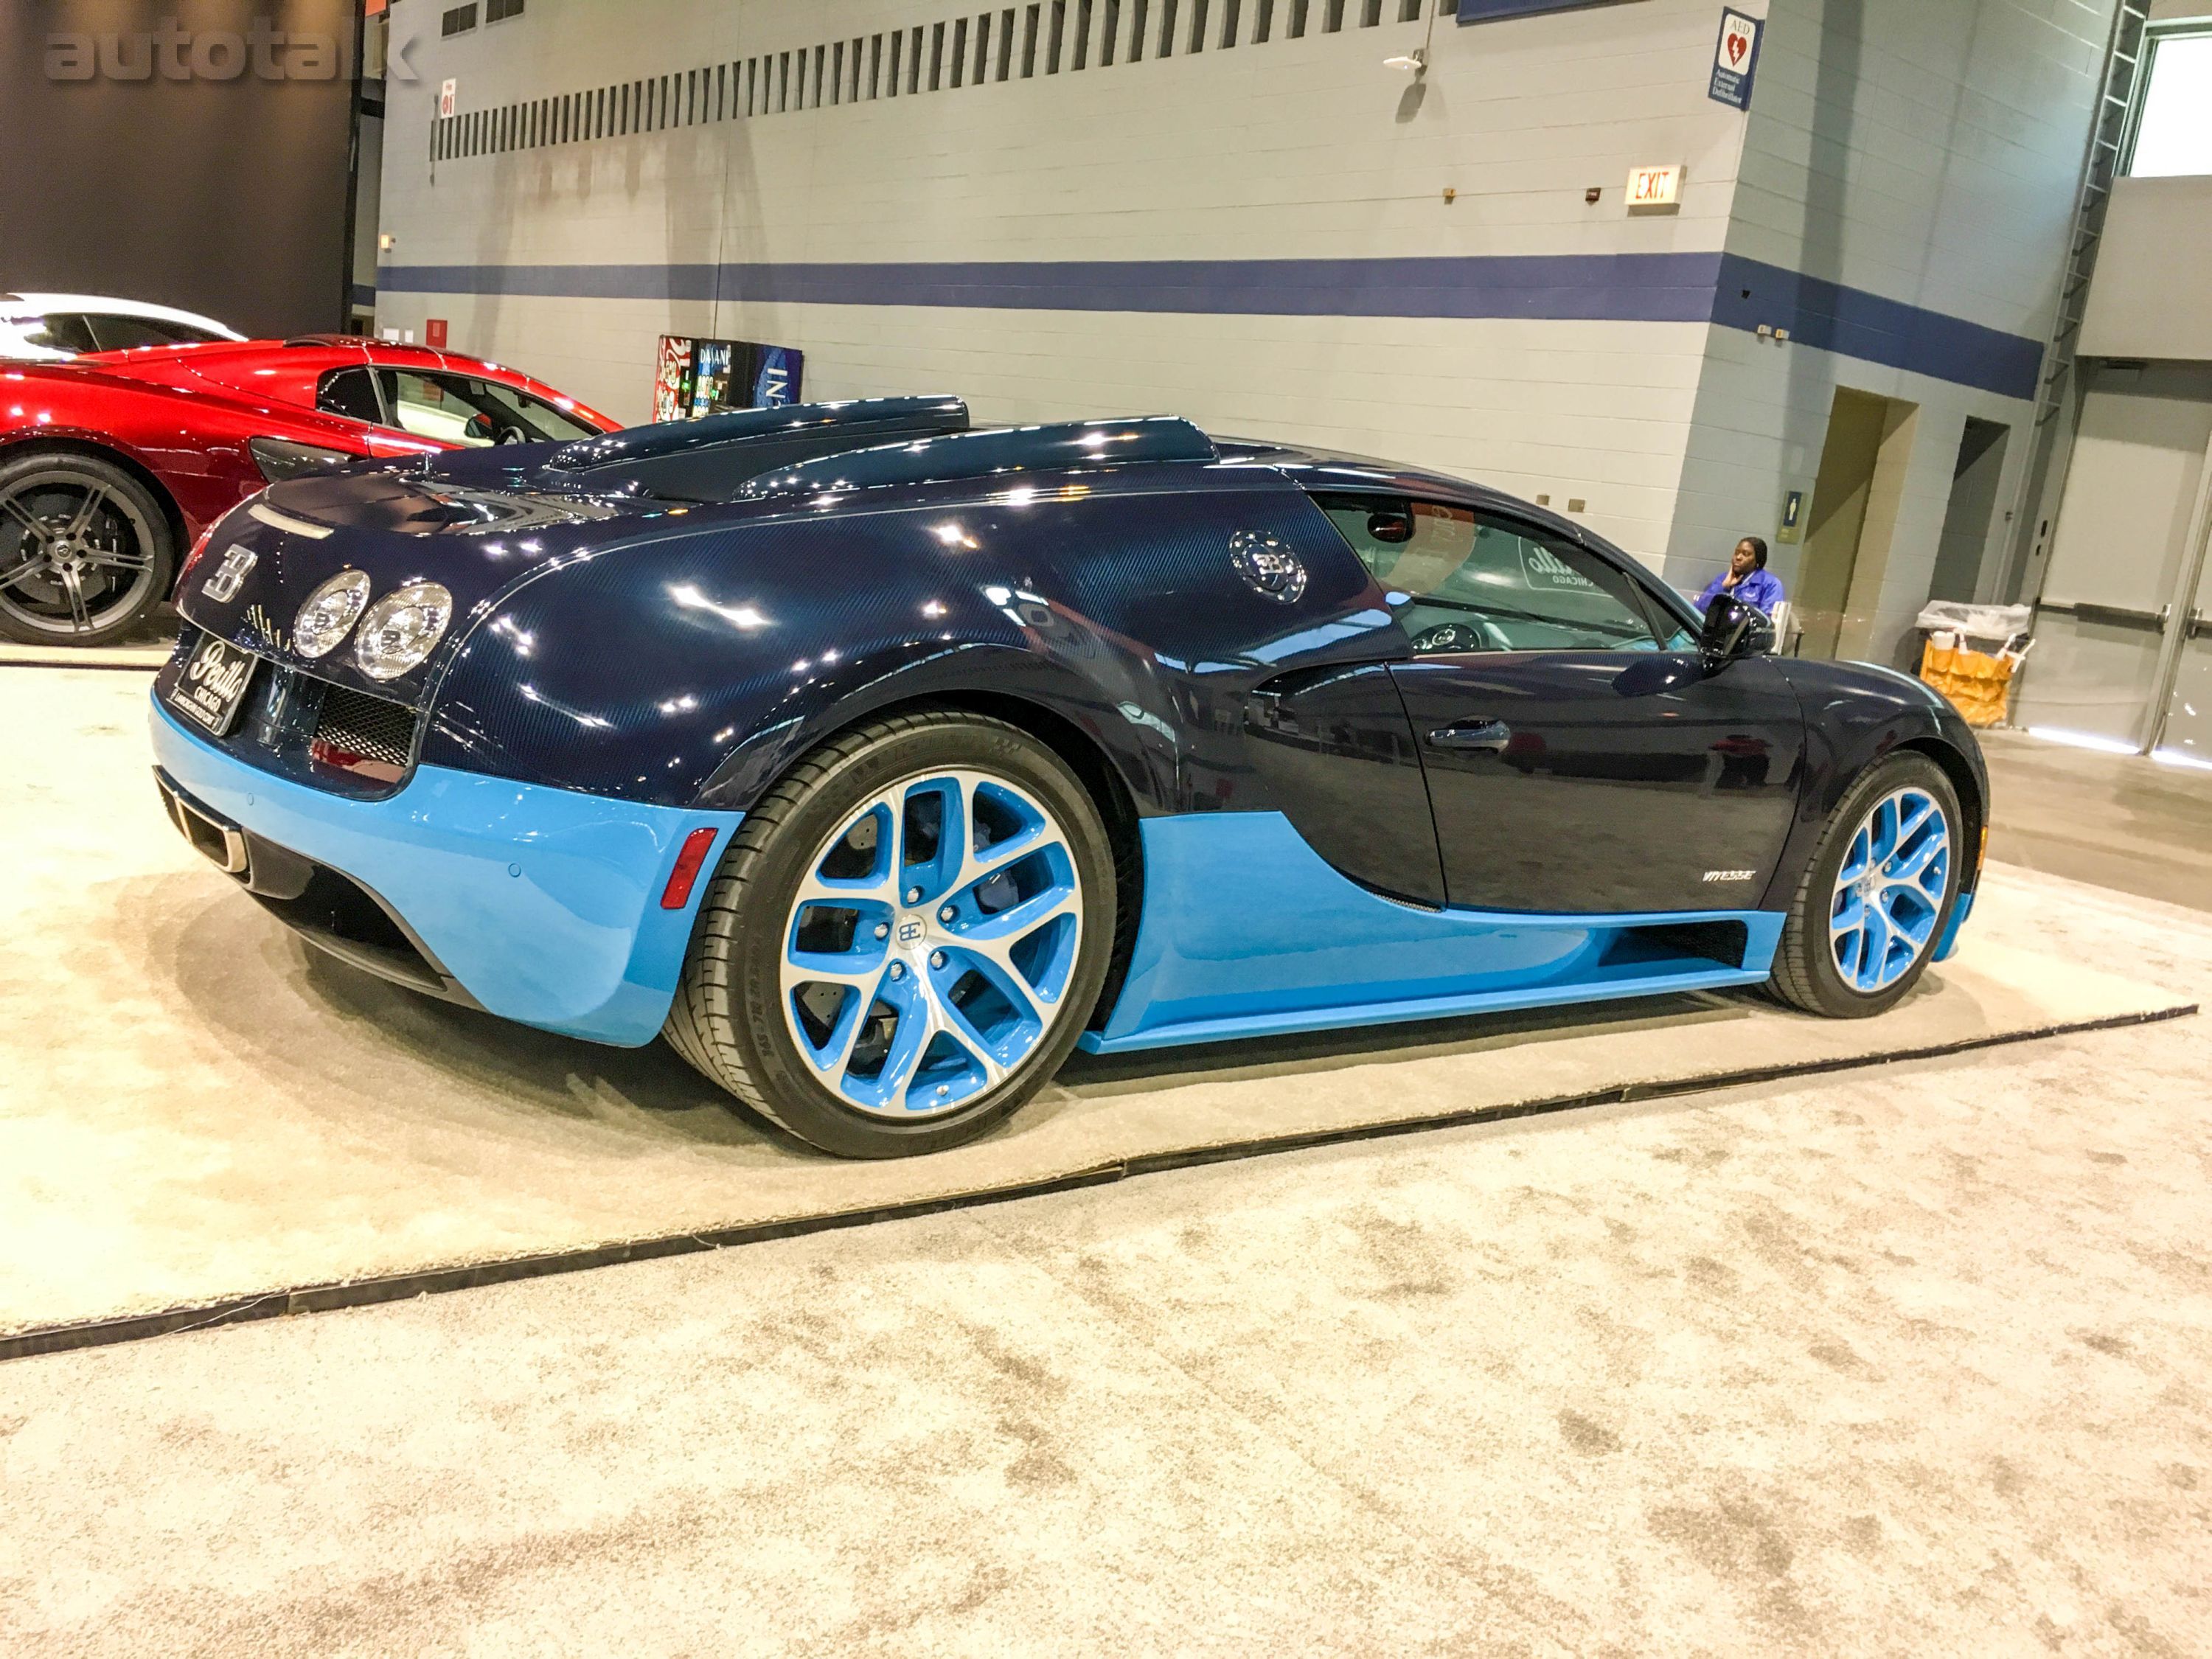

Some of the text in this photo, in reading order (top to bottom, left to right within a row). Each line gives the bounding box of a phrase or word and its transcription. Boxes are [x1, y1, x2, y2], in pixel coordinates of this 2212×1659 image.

[1729, 20, 1750, 35] AED
[1635, 172, 1669, 199] EXIT
[700, 348, 729, 366] DASANI
[194, 686, 221, 713] CHICAGO
[1703, 870, 1756, 882] VITESSE
